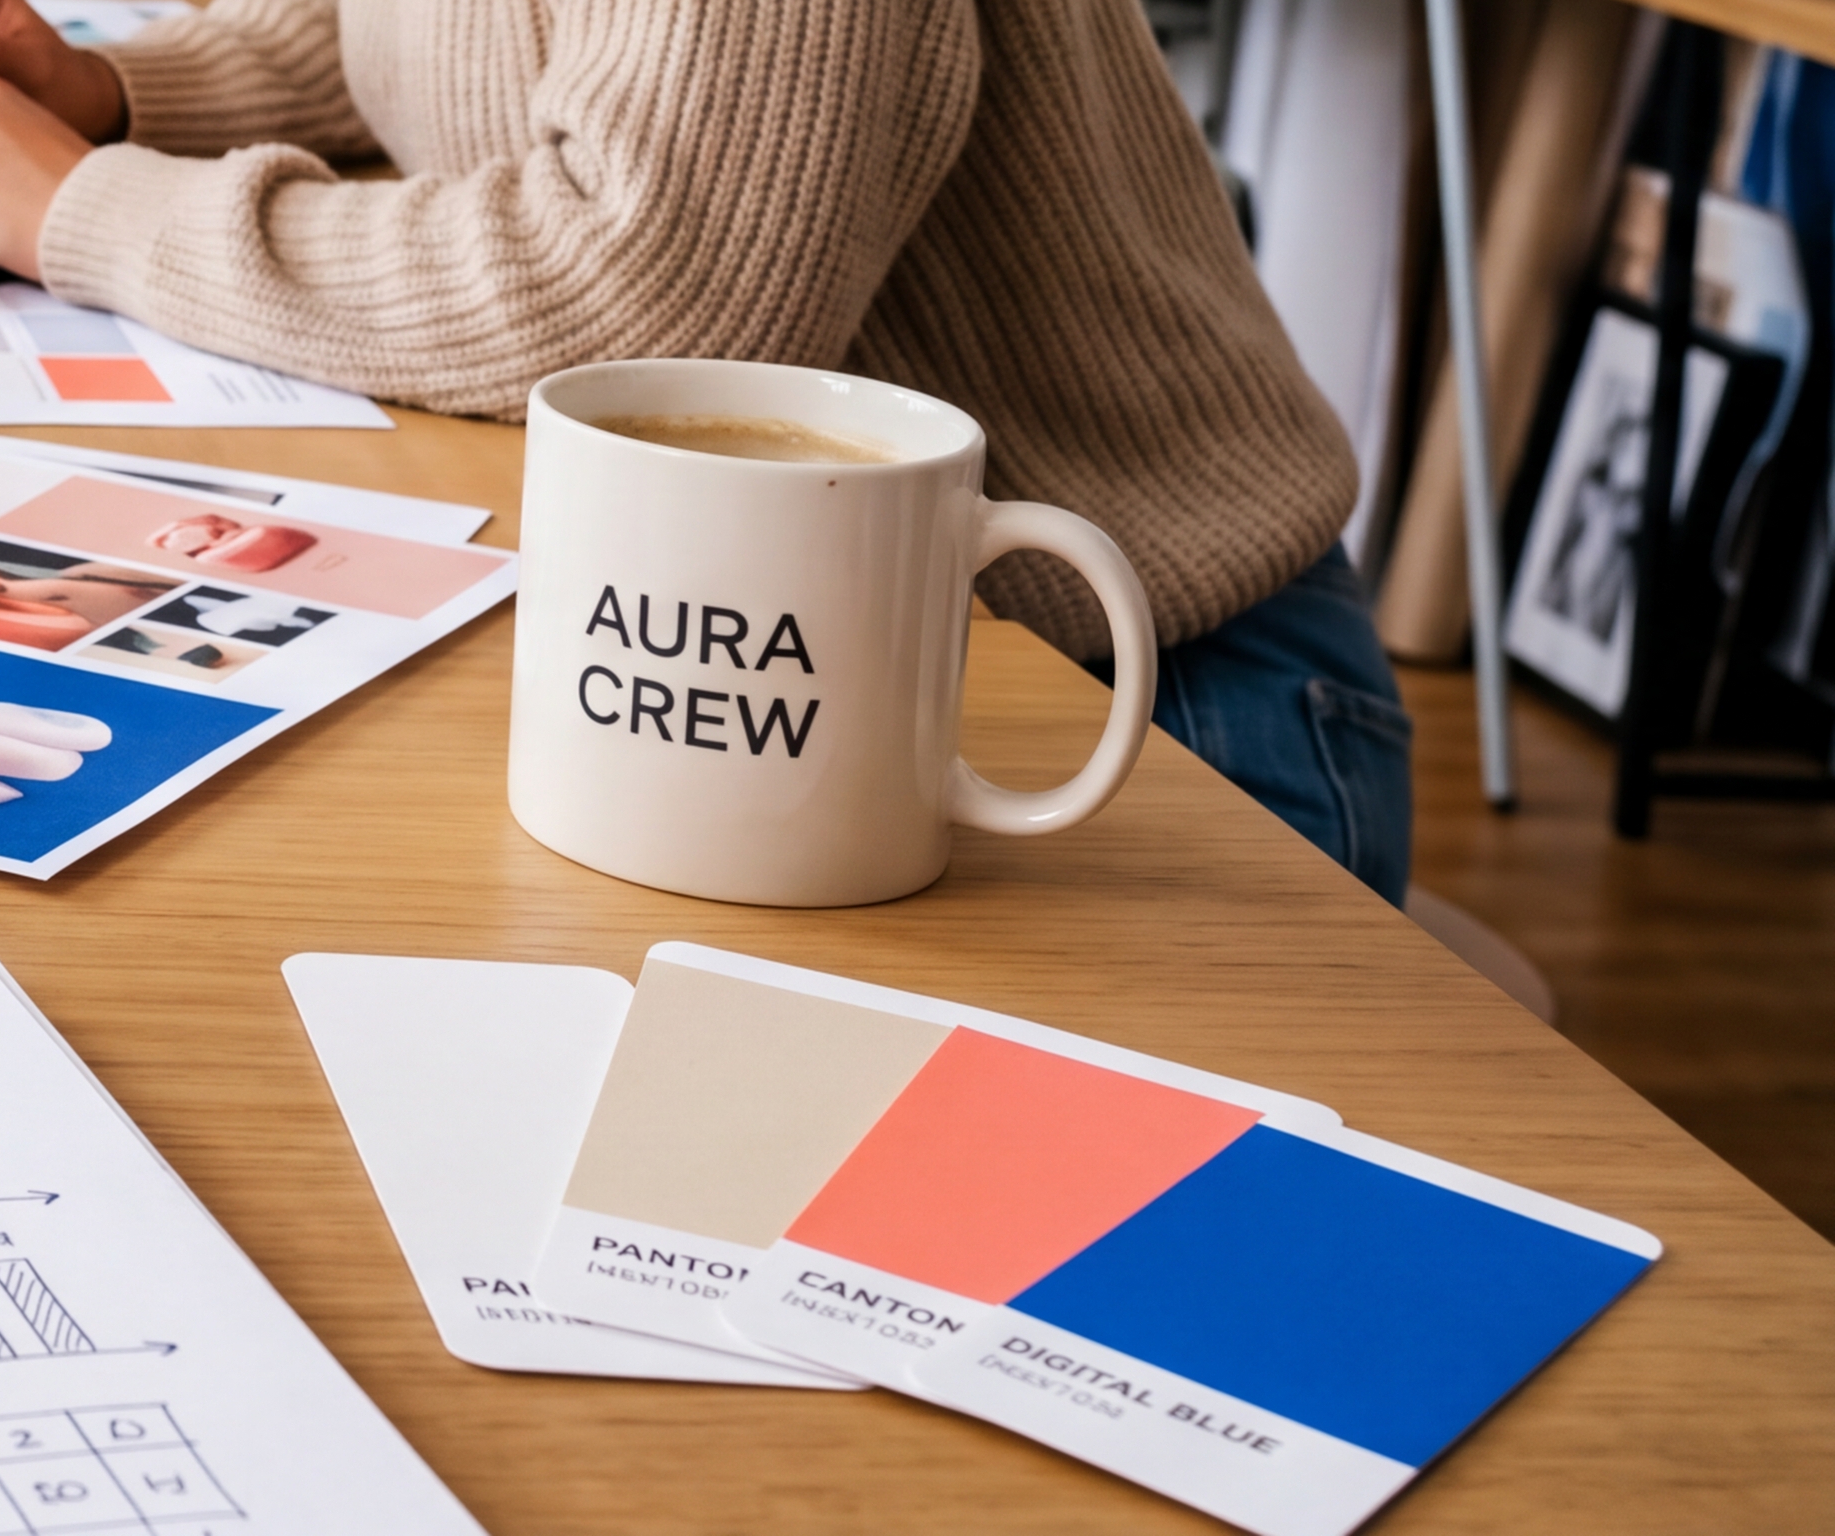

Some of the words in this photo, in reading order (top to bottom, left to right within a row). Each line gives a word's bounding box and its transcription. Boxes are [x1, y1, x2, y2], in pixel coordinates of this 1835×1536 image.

[585, 584, 815, 675] AURA
[578, 664, 820, 758] CREW
[798, 1271, 966, 1334] CANTON
[998, 1335, 1157, 1409] DIGITAL
[1165, 1402, 1284, 1457] BLUE
